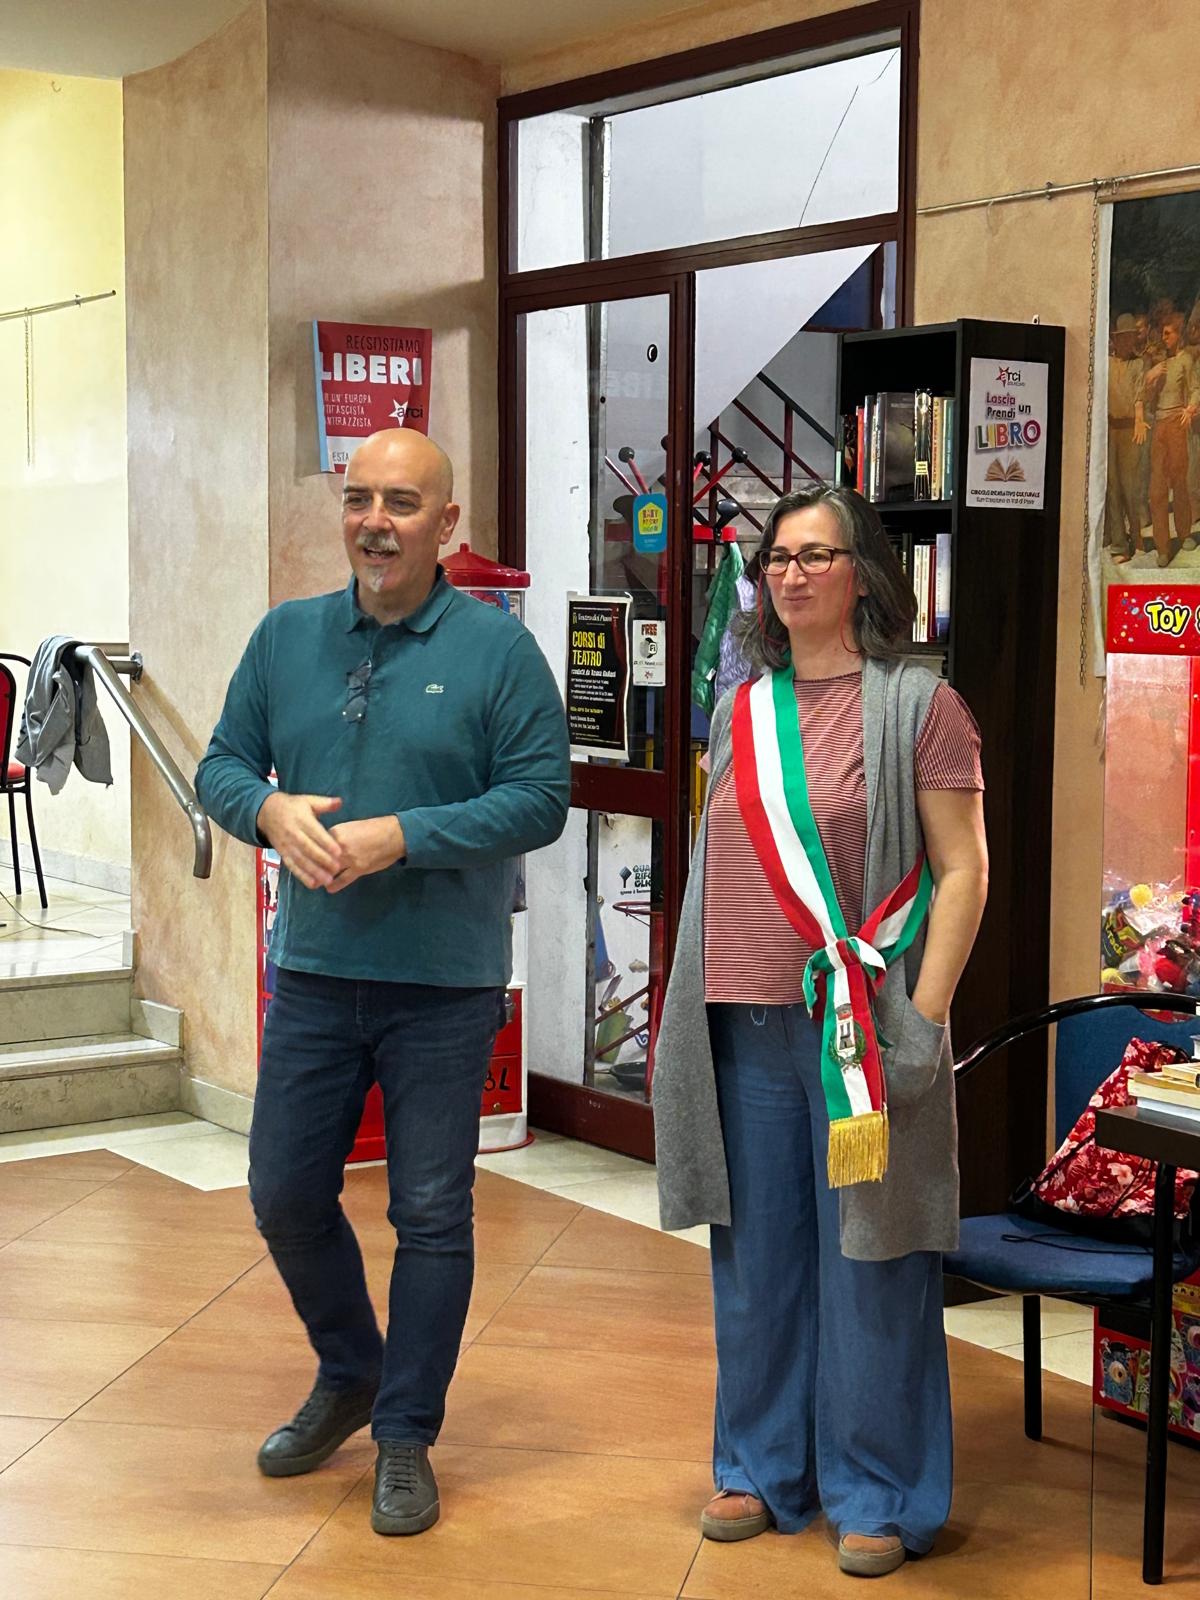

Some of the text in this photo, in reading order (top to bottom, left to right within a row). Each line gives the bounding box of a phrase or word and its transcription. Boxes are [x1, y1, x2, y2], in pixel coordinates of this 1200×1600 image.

[320, 351, 423, 386] LIBERI
[1000, 370, 1021, 382] arci
[344, 393, 372, 404] EUROPA
[986, 391, 1016, 406] Lascia
[397, 405, 423, 418] arci
[987, 406, 1016, 419] Prendi
[1018, 404, 1032, 414] un
[976, 419, 1041, 450] LIBRO
[1145, 600, 1191, 637] Toy
[572, 630, 606, 649] CORSI di
[572, 649, 602, 667] TEATRO
